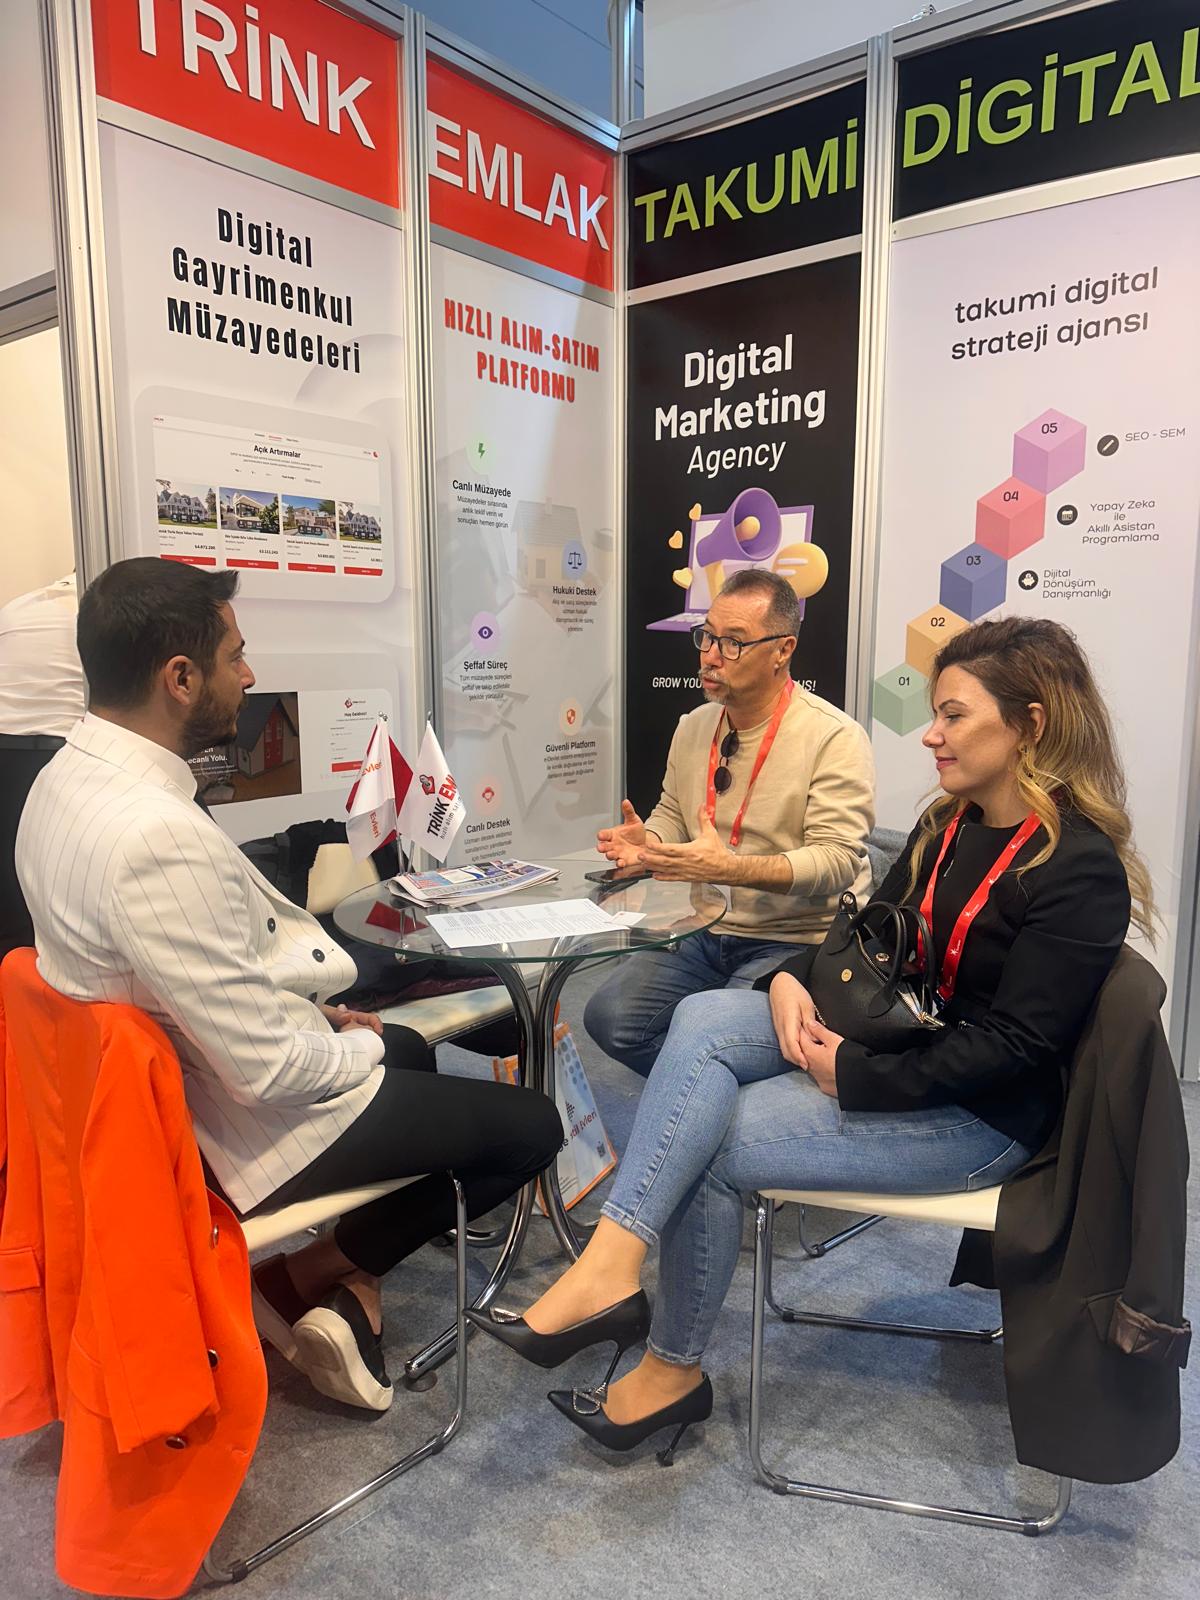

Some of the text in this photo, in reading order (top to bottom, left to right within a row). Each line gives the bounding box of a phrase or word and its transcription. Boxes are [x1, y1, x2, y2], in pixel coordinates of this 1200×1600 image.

[903, 27, 1200, 168] DİGİTAL
[427, 110, 611, 251] EMLAK
[634, 119, 858, 243] TAKUMİ
[217, 207, 312, 268] Digital
[172, 246, 352, 326] Gayrimenkul
[955, 266, 1158, 324] takumi digital
[167, 296, 360, 374] Müzayedeleri
[444, 298, 599, 372] HIZLI ALIM-SATIM
[951, 312, 1148, 360] strateji ajansı
[684, 333, 793, 391] Digital
[477, 351, 575, 403] PLATFORMU
[655, 387, 826, 441] Marketing
[1041, 422, 1058, 434] 05
[1125, 430, 1149, 442] SEO
[1160, 428, 1186, 440] SEM
[253, 444, 301, 459] Açık Artırmalar
[686, 441, 786, 479] Agency
[452, 479, 512, 498] Canlı Müzayede
[1003, 490, 1019, 502] 04
[1090, 500, 1156, 513] Yapay Zeka
[1113, 512, 1126, 521] ile
[1087, 522, 1156, 533] Akıllı Asistan
[1082, 533, 1160, 545] Programlama
[966, 555, 981, 566] 03
[1043, 568, 1071, 580] Dijital
[552, 585, 597, 596] Hukuki Destek
[1043, 578, 1096, 590] Dönüşüm
[1042, 588, 1111, 600] Danışmanlığı
[930, 617, 946, 628] 02
[463, 660, 508, 672] Şeffaf Süreç
[652, 677, 681, 688] GROW
[683, 677, 704, 689] YOU
[898, 676, 911, 687] 01
[545, 740, 596, 753] Güvenli Platform
[210, 754, 228, 762] Yolu.
[427, 774, 457, 837] TRİNK EM
[369, 811, 382, 839] Evleri
[466, 817, 511, 834] Canlı Destek
